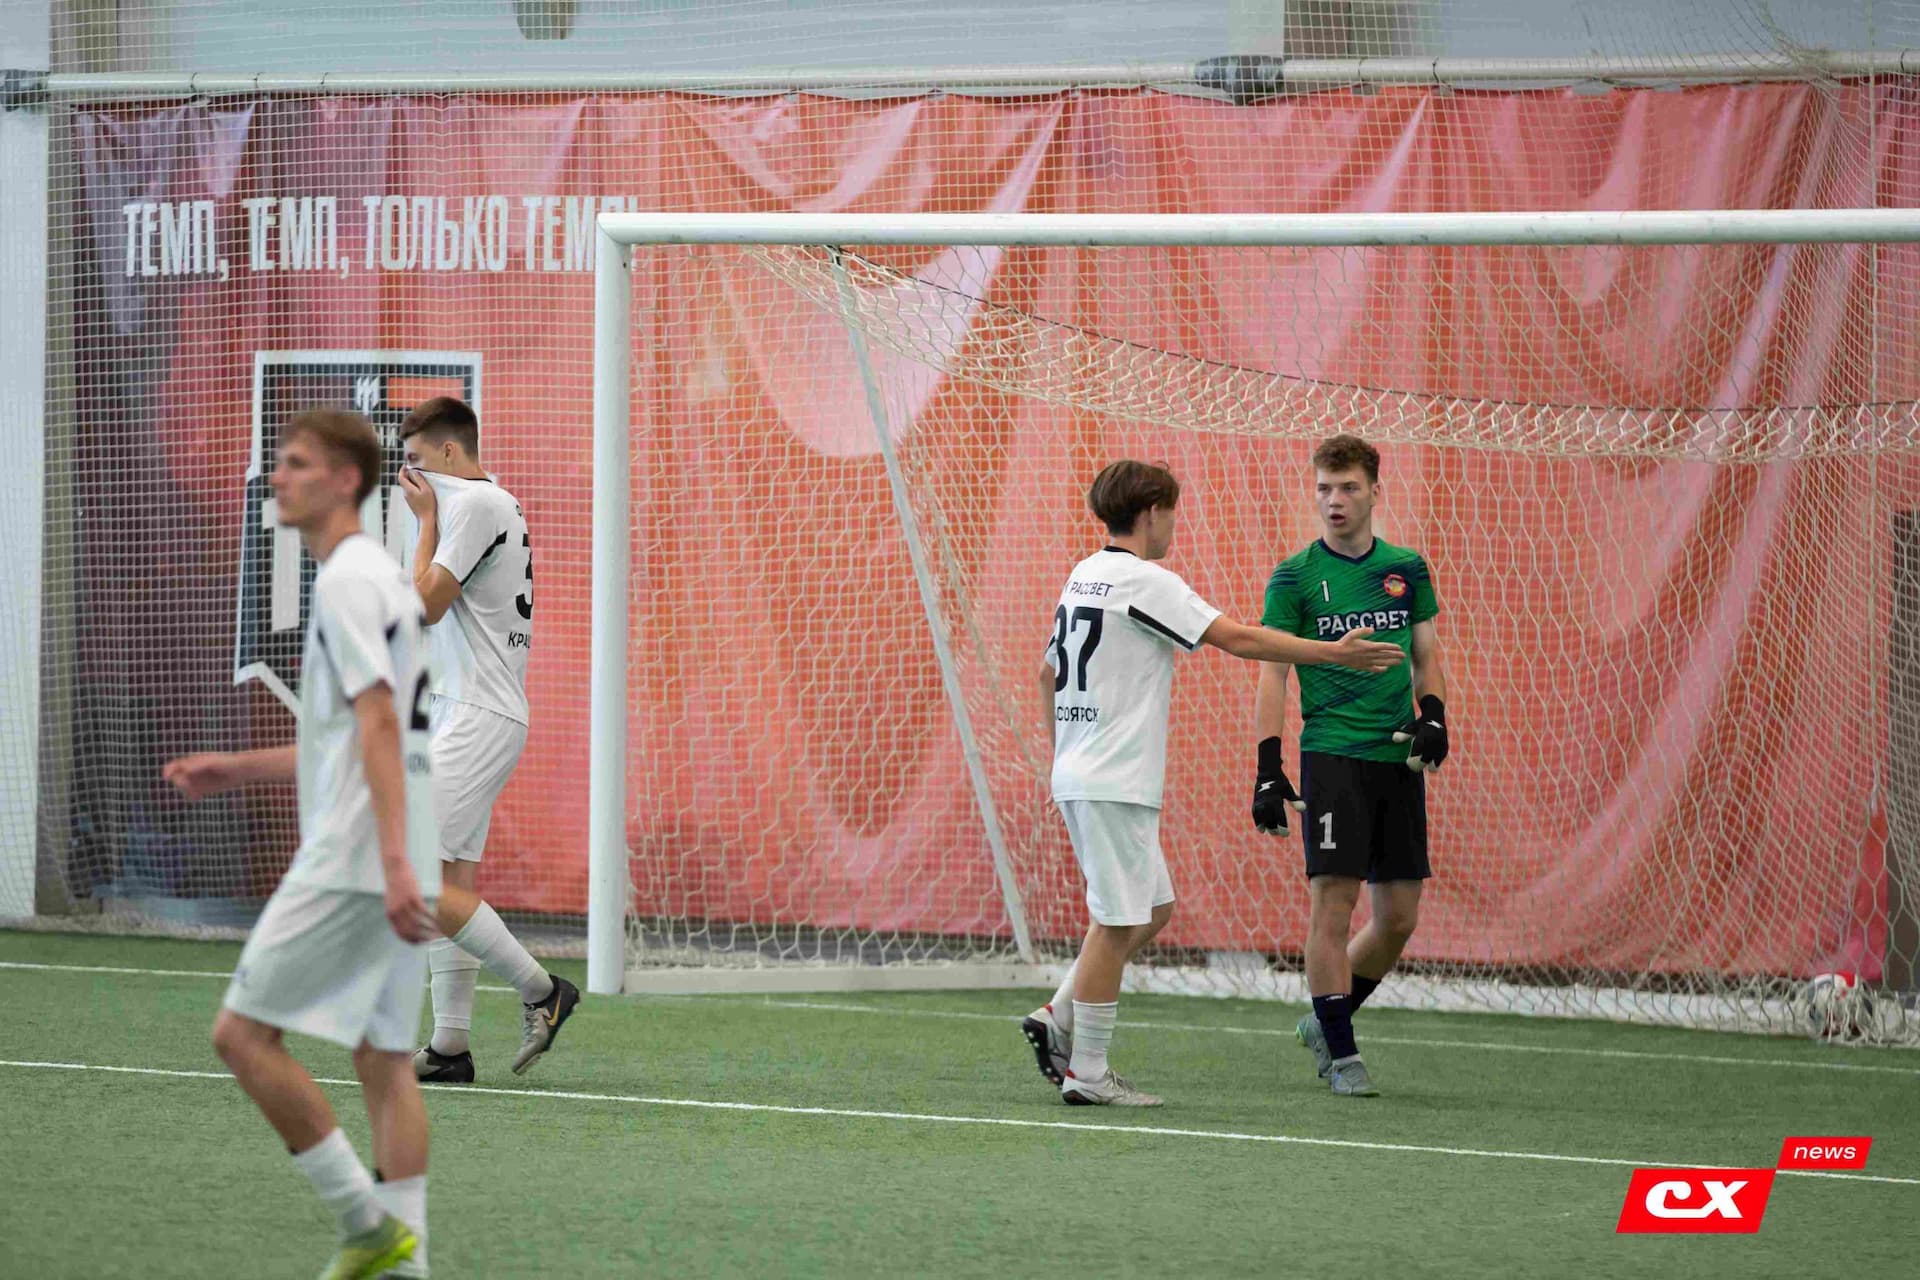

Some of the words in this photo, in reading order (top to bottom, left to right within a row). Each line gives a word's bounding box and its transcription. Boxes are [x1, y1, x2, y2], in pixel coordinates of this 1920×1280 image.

[123, 201, 229, 282] ТЕМП,
[242, 196, 349, 279] ТЕМП,
[363, 194, 509, 272] ТОЛЬКО
[523, 195, 638, 272] ТЕМ
[1321, 579, 1329, 603] 1
[1317, 609, 1409, 637] РАССВЕТ
[1319, 812, 1337, 849] 1
